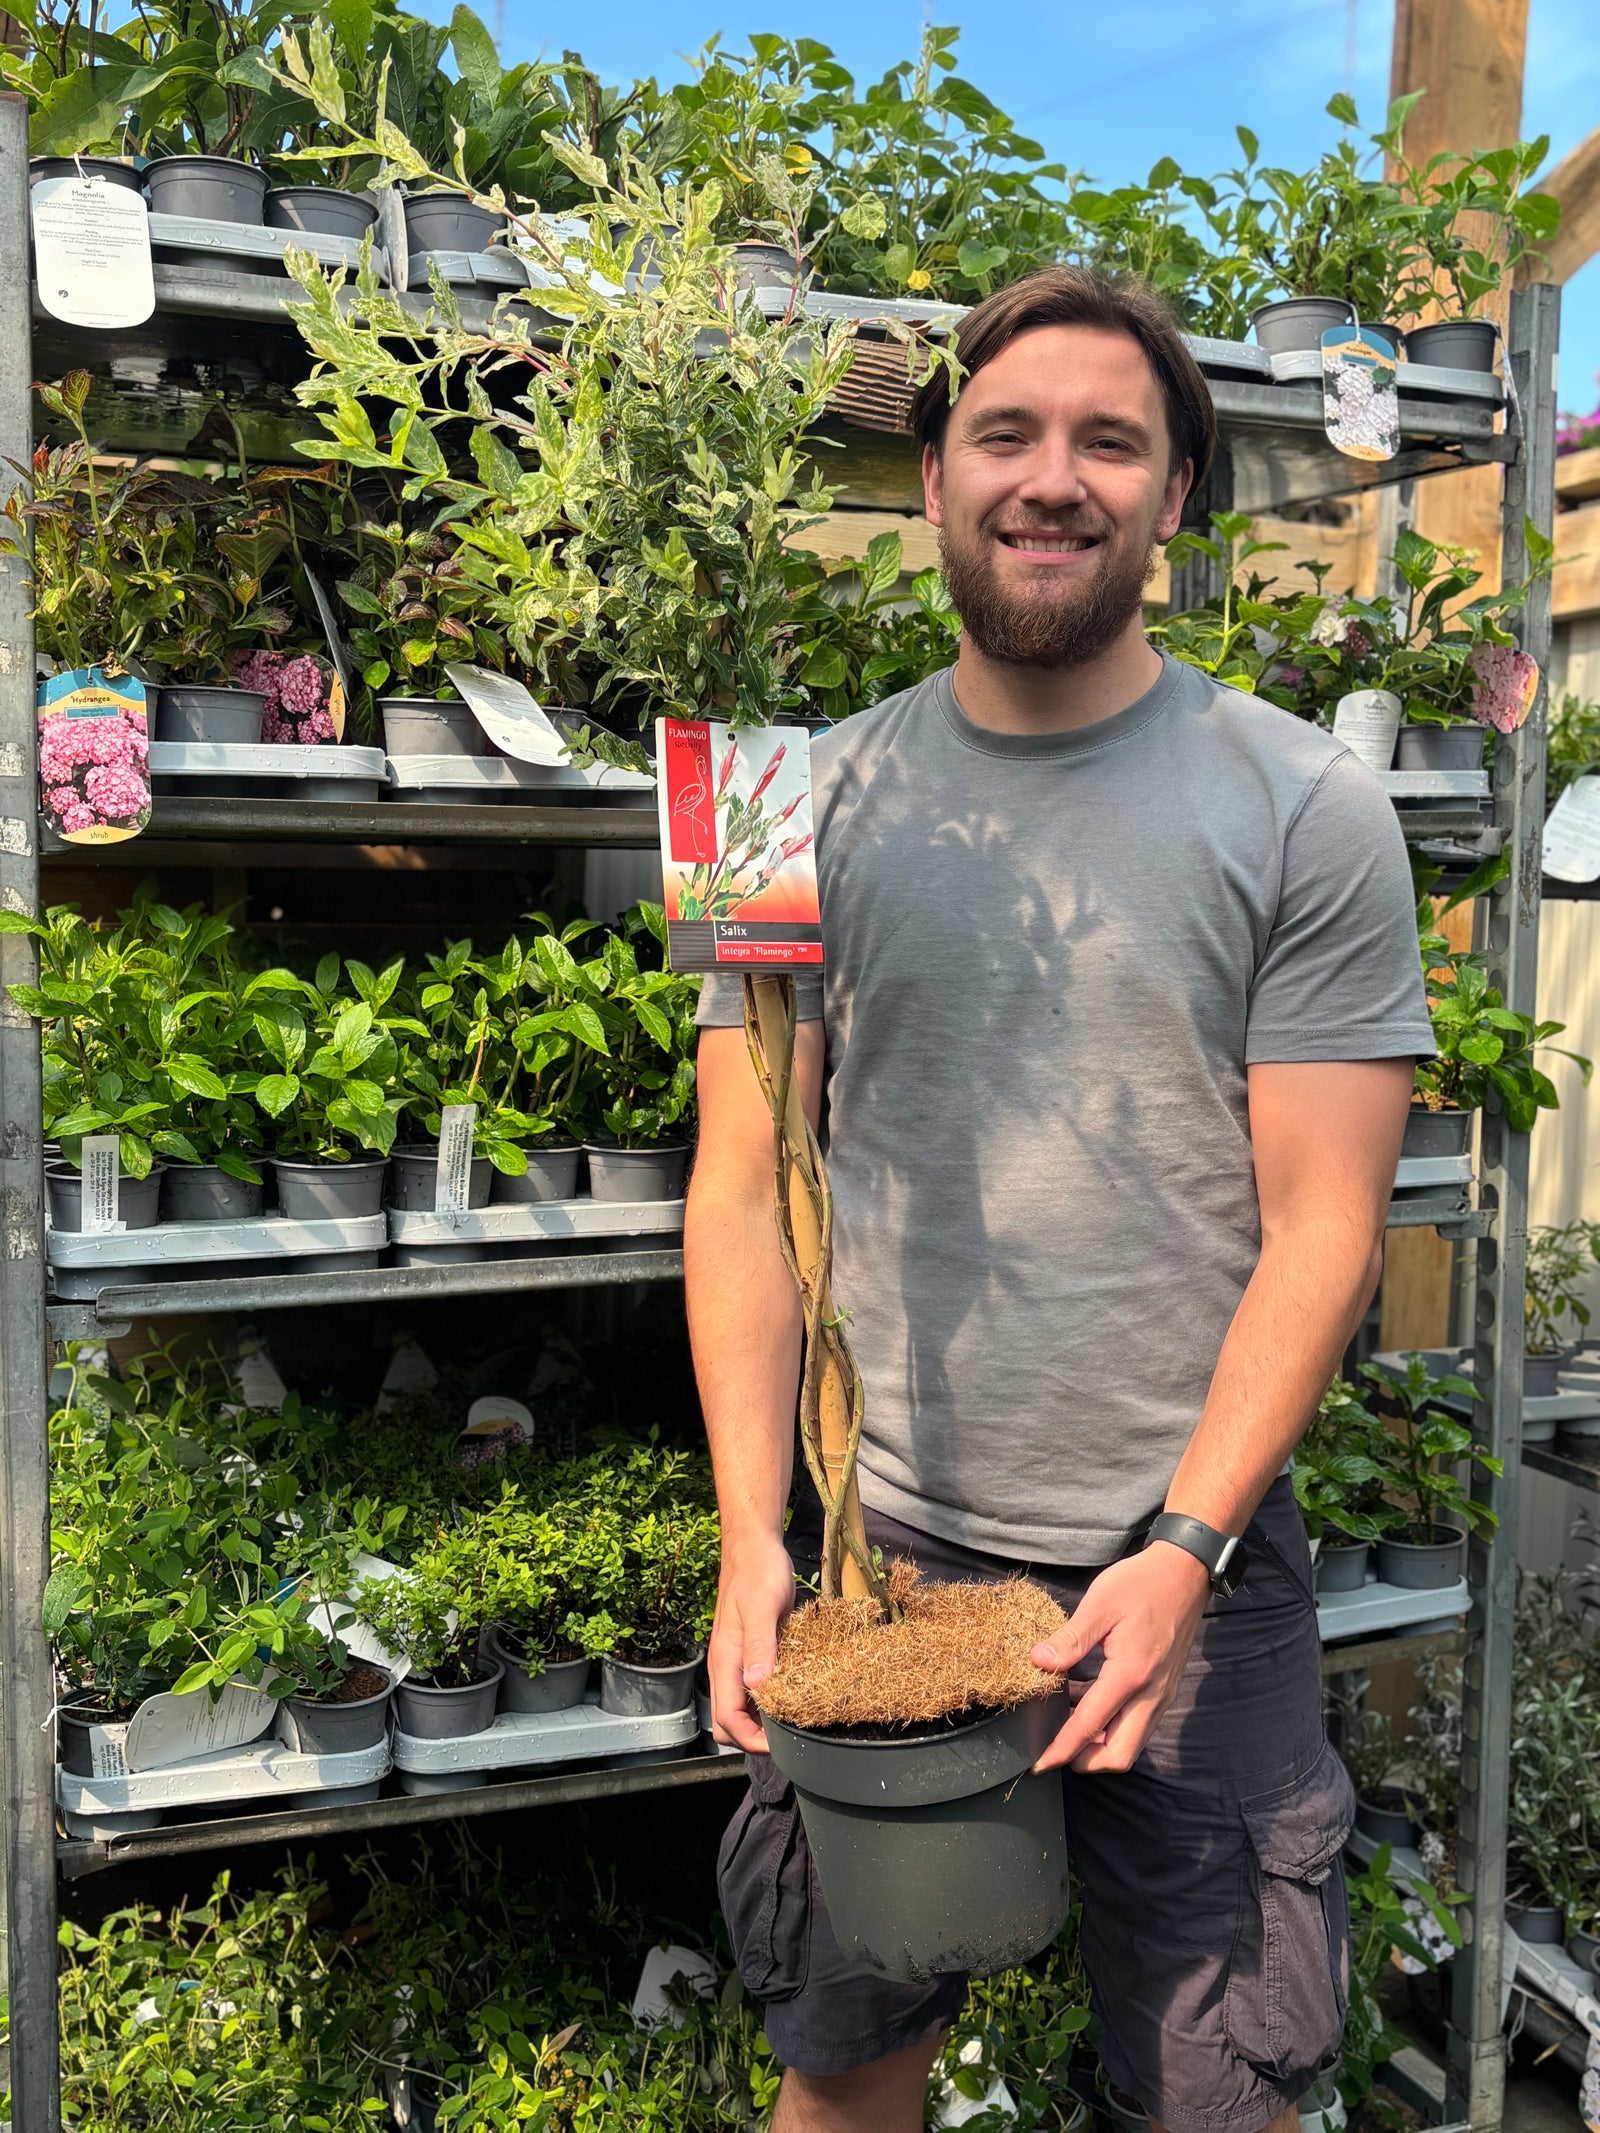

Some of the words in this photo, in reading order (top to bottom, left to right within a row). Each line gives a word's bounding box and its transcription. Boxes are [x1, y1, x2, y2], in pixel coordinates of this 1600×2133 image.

[72, 190, 105, 199] Magnolia
[71, 696, 110, 704] Hydrangea
[668, 727, 706, 740] FLAMINGO
[720, 925, 747, 936] Salix
[722, 947, 750, 957] integra
